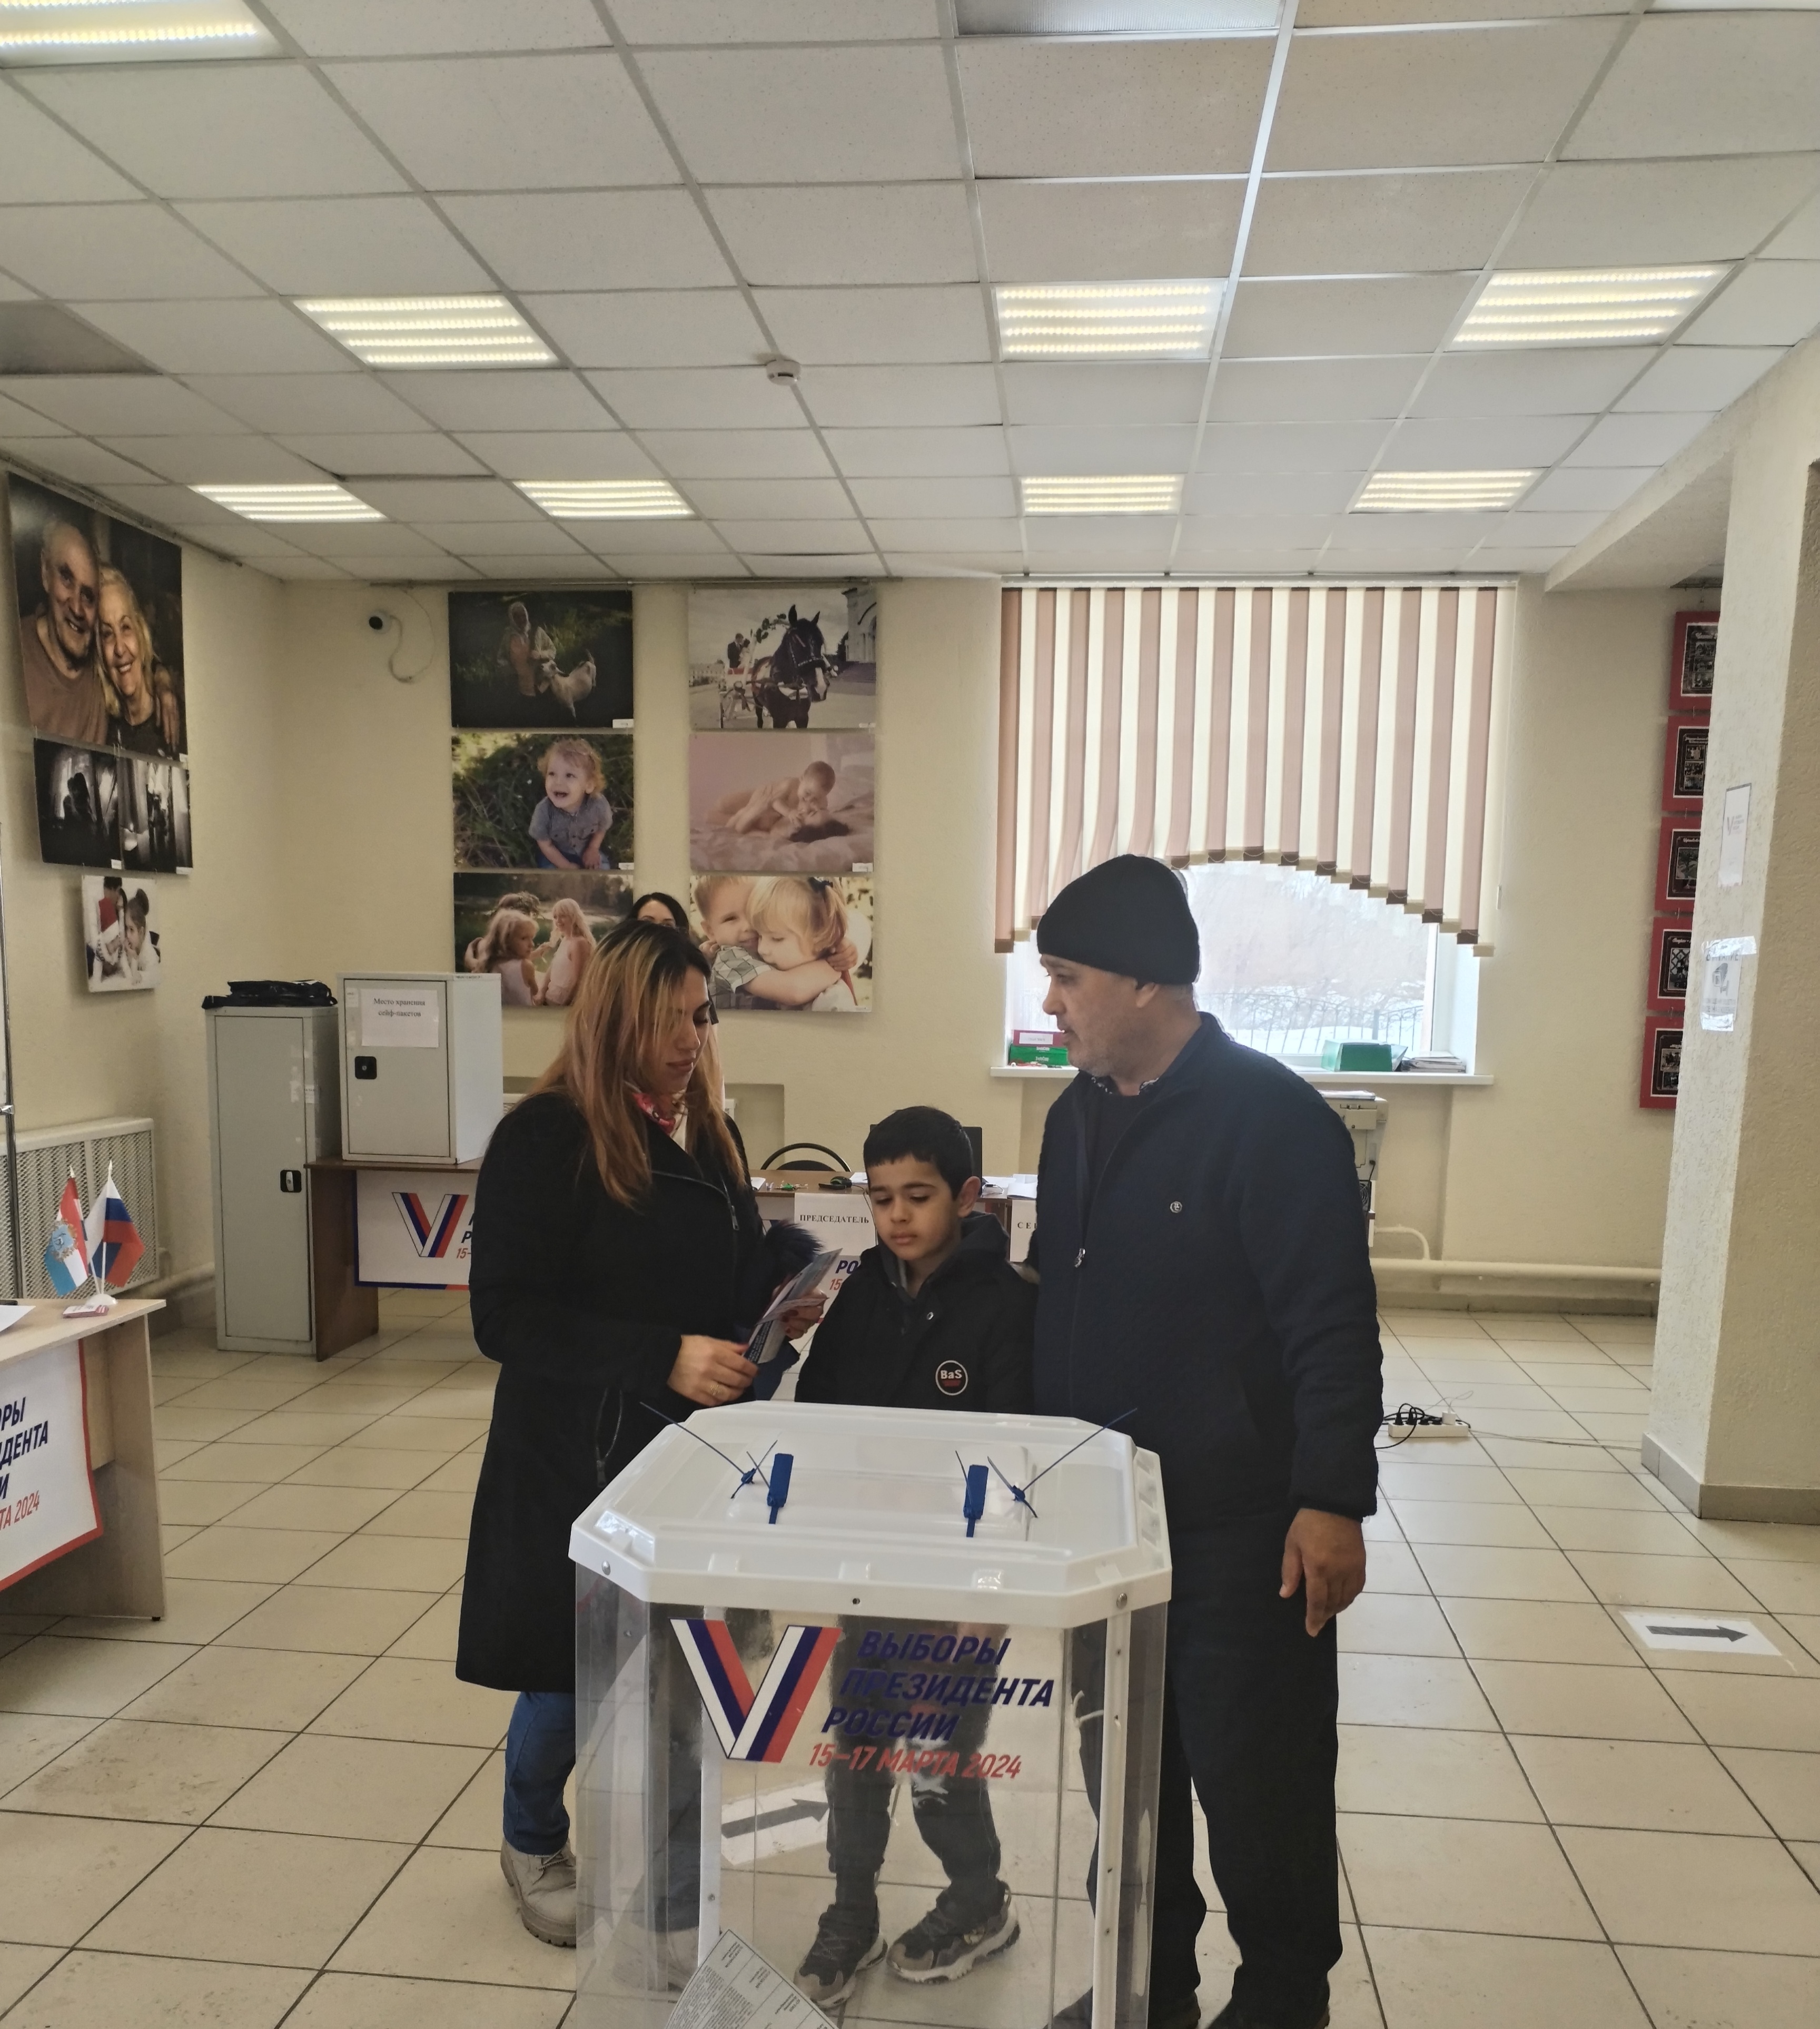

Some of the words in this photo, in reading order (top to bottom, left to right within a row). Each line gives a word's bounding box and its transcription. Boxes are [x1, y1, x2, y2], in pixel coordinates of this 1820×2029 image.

[378, 1009, 421, 1018] сейф-пакетов
[799, 1214, 869, 1224] ПРЕДСЕДАТЕЛЬ
[941, 1370, 962, 1379] BaS
[14, 1490, 40, 1523] 2024
[857, 1630, 1012, 1666] ВЫБОРЫ
[839, 1668, 1055, 1707] ПРЕЗИДЕНТА
[821, 1706, 961, 1741] РОССИИ
[875, 1748, 960, 1777] МАРТА
[961, 1754, 1022, 1779] 2024
